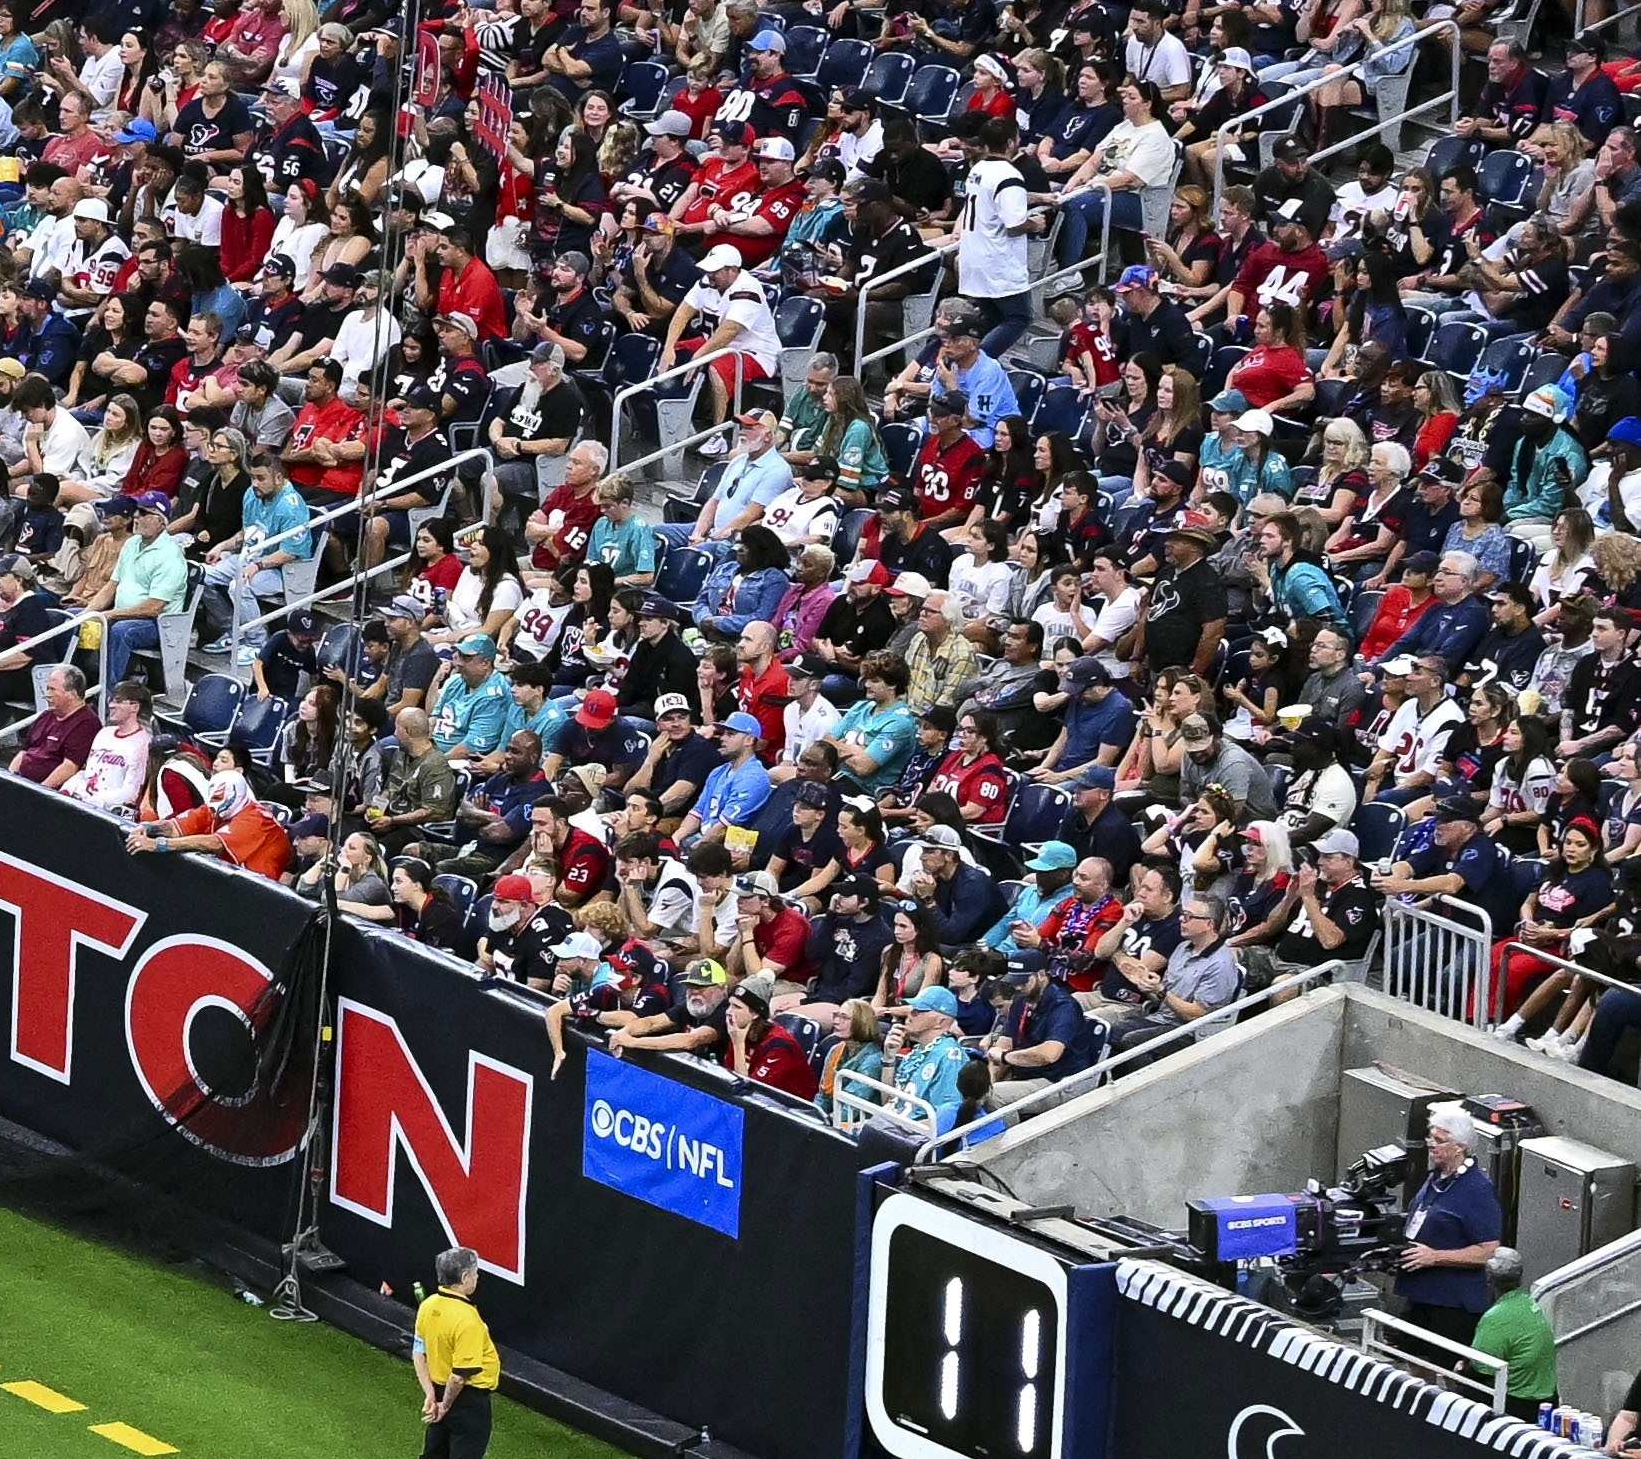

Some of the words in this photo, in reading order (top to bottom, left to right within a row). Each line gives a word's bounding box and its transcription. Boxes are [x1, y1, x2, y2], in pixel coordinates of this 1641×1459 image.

[282, 161, 300, 177] 56
[770, 202, 789, 218] 99
[1257, 265, 1300, 306] 44
[521, 608, 553, 640] 99
[980, 782, 999, 799] 80
[568, 868, 588, 883] 23
[615, 1109, 663, 1161] CBS
[678, 1133, 734, 1189] NFL
[939, 1276, 1042, 1454] 11
